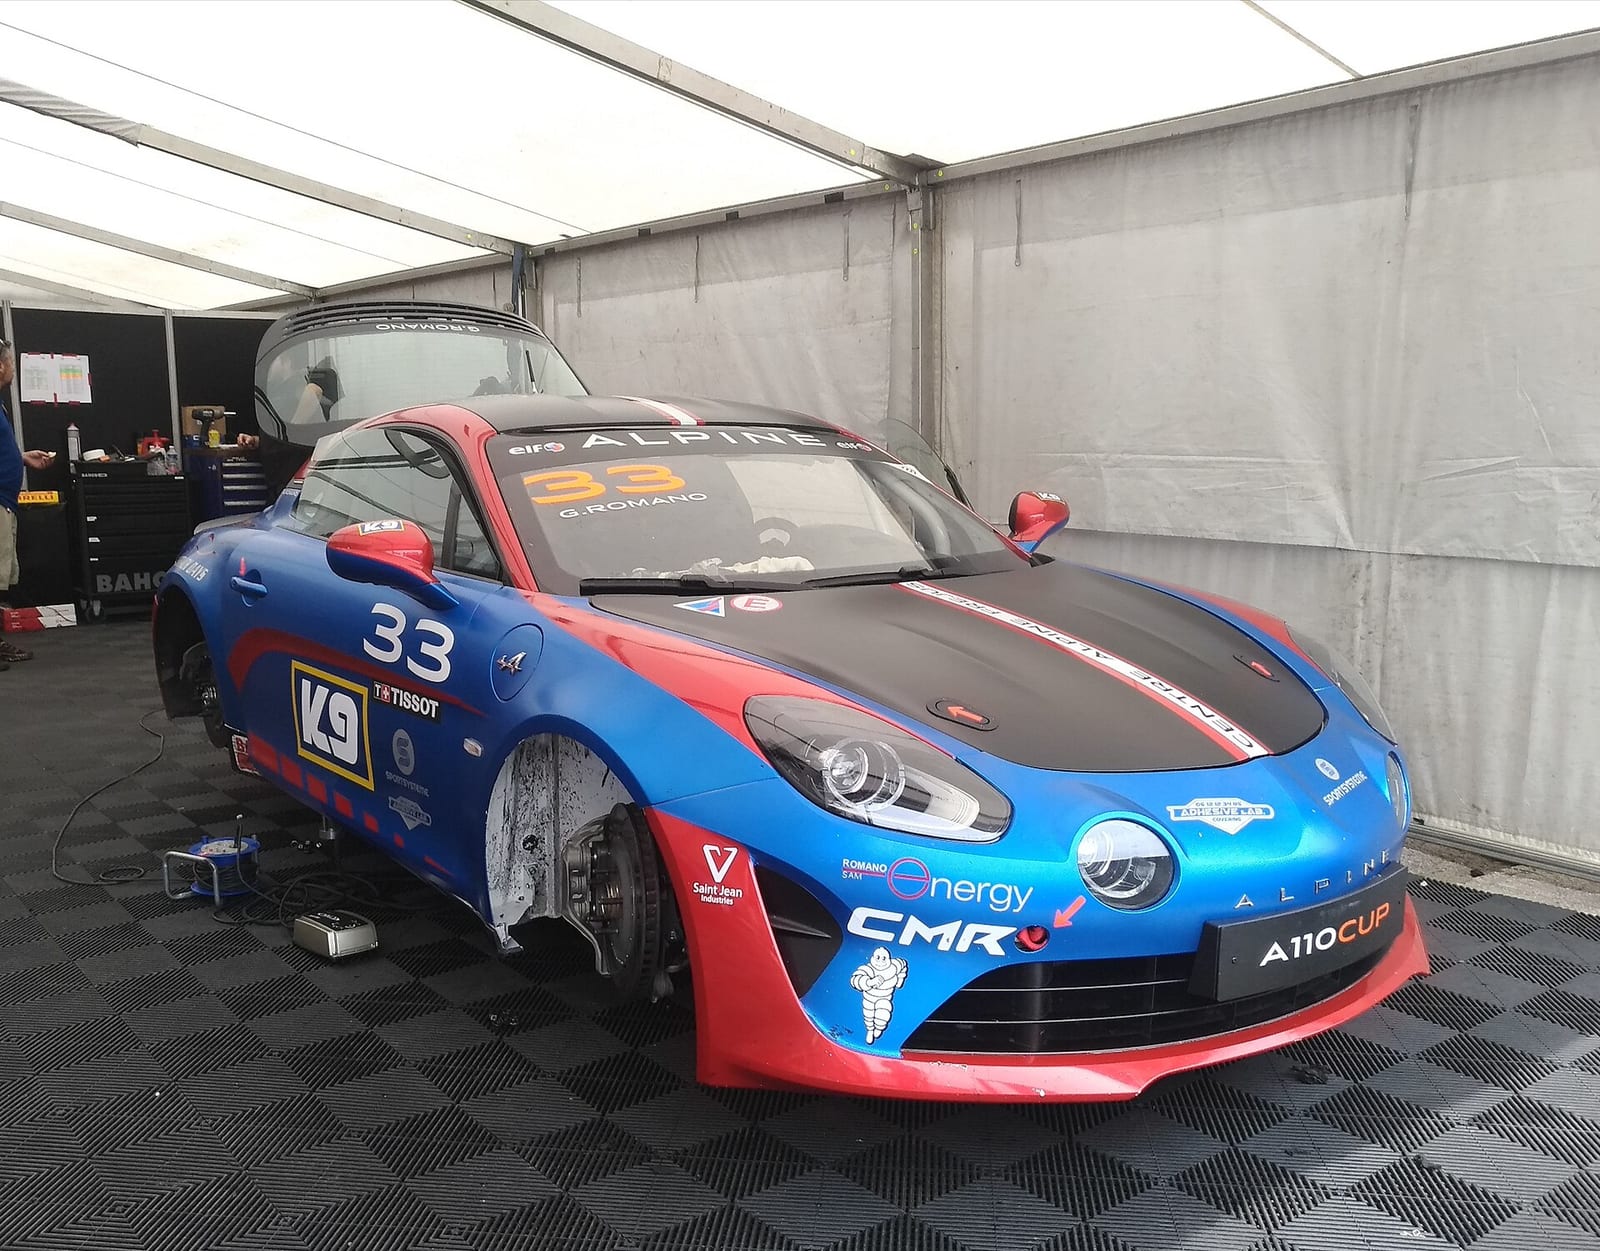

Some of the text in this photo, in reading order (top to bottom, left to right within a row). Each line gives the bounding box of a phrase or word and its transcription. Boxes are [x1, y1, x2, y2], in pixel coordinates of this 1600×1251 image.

[582, 431, 827, 448] ALPINE
[523, 464, 686, 505] 33
[559, 492, 708, 519] G.ROMANO
[363, 520, 399, 532] K9
[96, 573, 165, 592] BAHC
[363, 602, 455, 683] 33
[1010, 619, 1115, 660] ALPINE
[391, 685, 440, 719] TISSOT
[1129, 670, 1253, 748] CENTRE
[301, 678, 359, 765] K9
[1181, 807, 1239, 817] ADHESIVE
[842, 858, 887, 873] ROMANO
[1234, 849, 1390, 909] ALPINE
[693, 882, 743, 898] Saint Jean
[701, 894, 734, 905] Industries
[847, 907, 1018, 956] CMR
